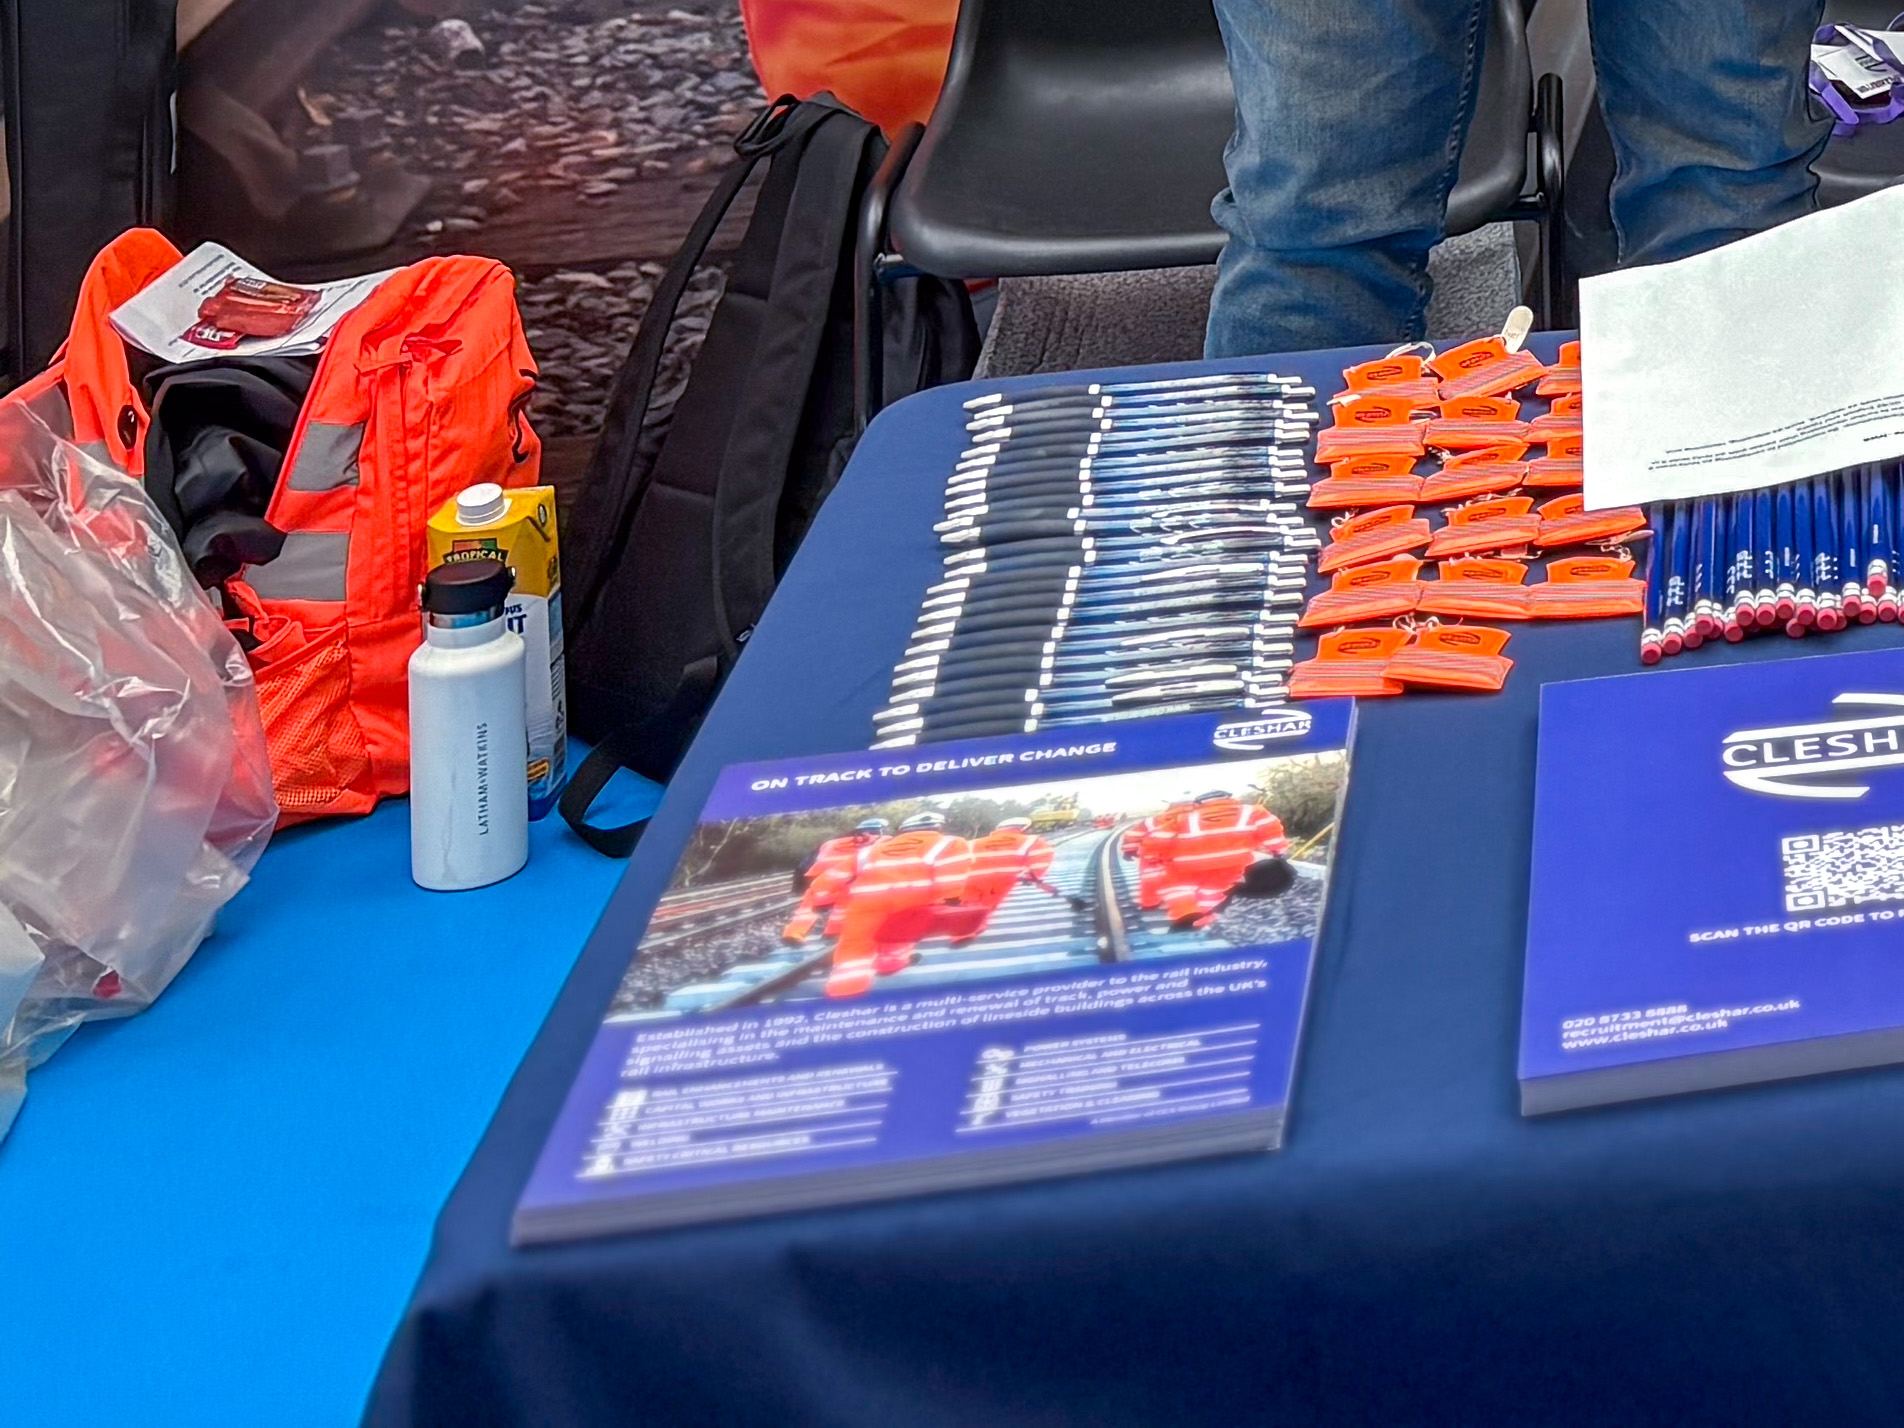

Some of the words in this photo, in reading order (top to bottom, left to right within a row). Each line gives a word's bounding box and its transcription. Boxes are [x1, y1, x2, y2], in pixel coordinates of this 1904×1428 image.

[446, 549, 504, 562] TROPICAL
[751, 778, 789, 792] ON
[793, 767, 874, 786] TRACK
[878, 763, 912, 778] TO
[916, 753, 1016, 773] DELIVER
[1020, 742, 1117, 762] CHANGE
[1689, 929, 1739, 943] SCAN
[1743, 924, 1781, 935] THE
[1783, 921, 1811, 933] QR
[1814, 913, 1865, 927] CODE
[1869, 910, 1894, 921] TO
[1562, 999, 1800, 1040] recruitment@cleshar.co.uk
[1562, 1018, 1596, 1029] 020
[1562, 1019, 1728, 1050] www.cleshar.co.uk
